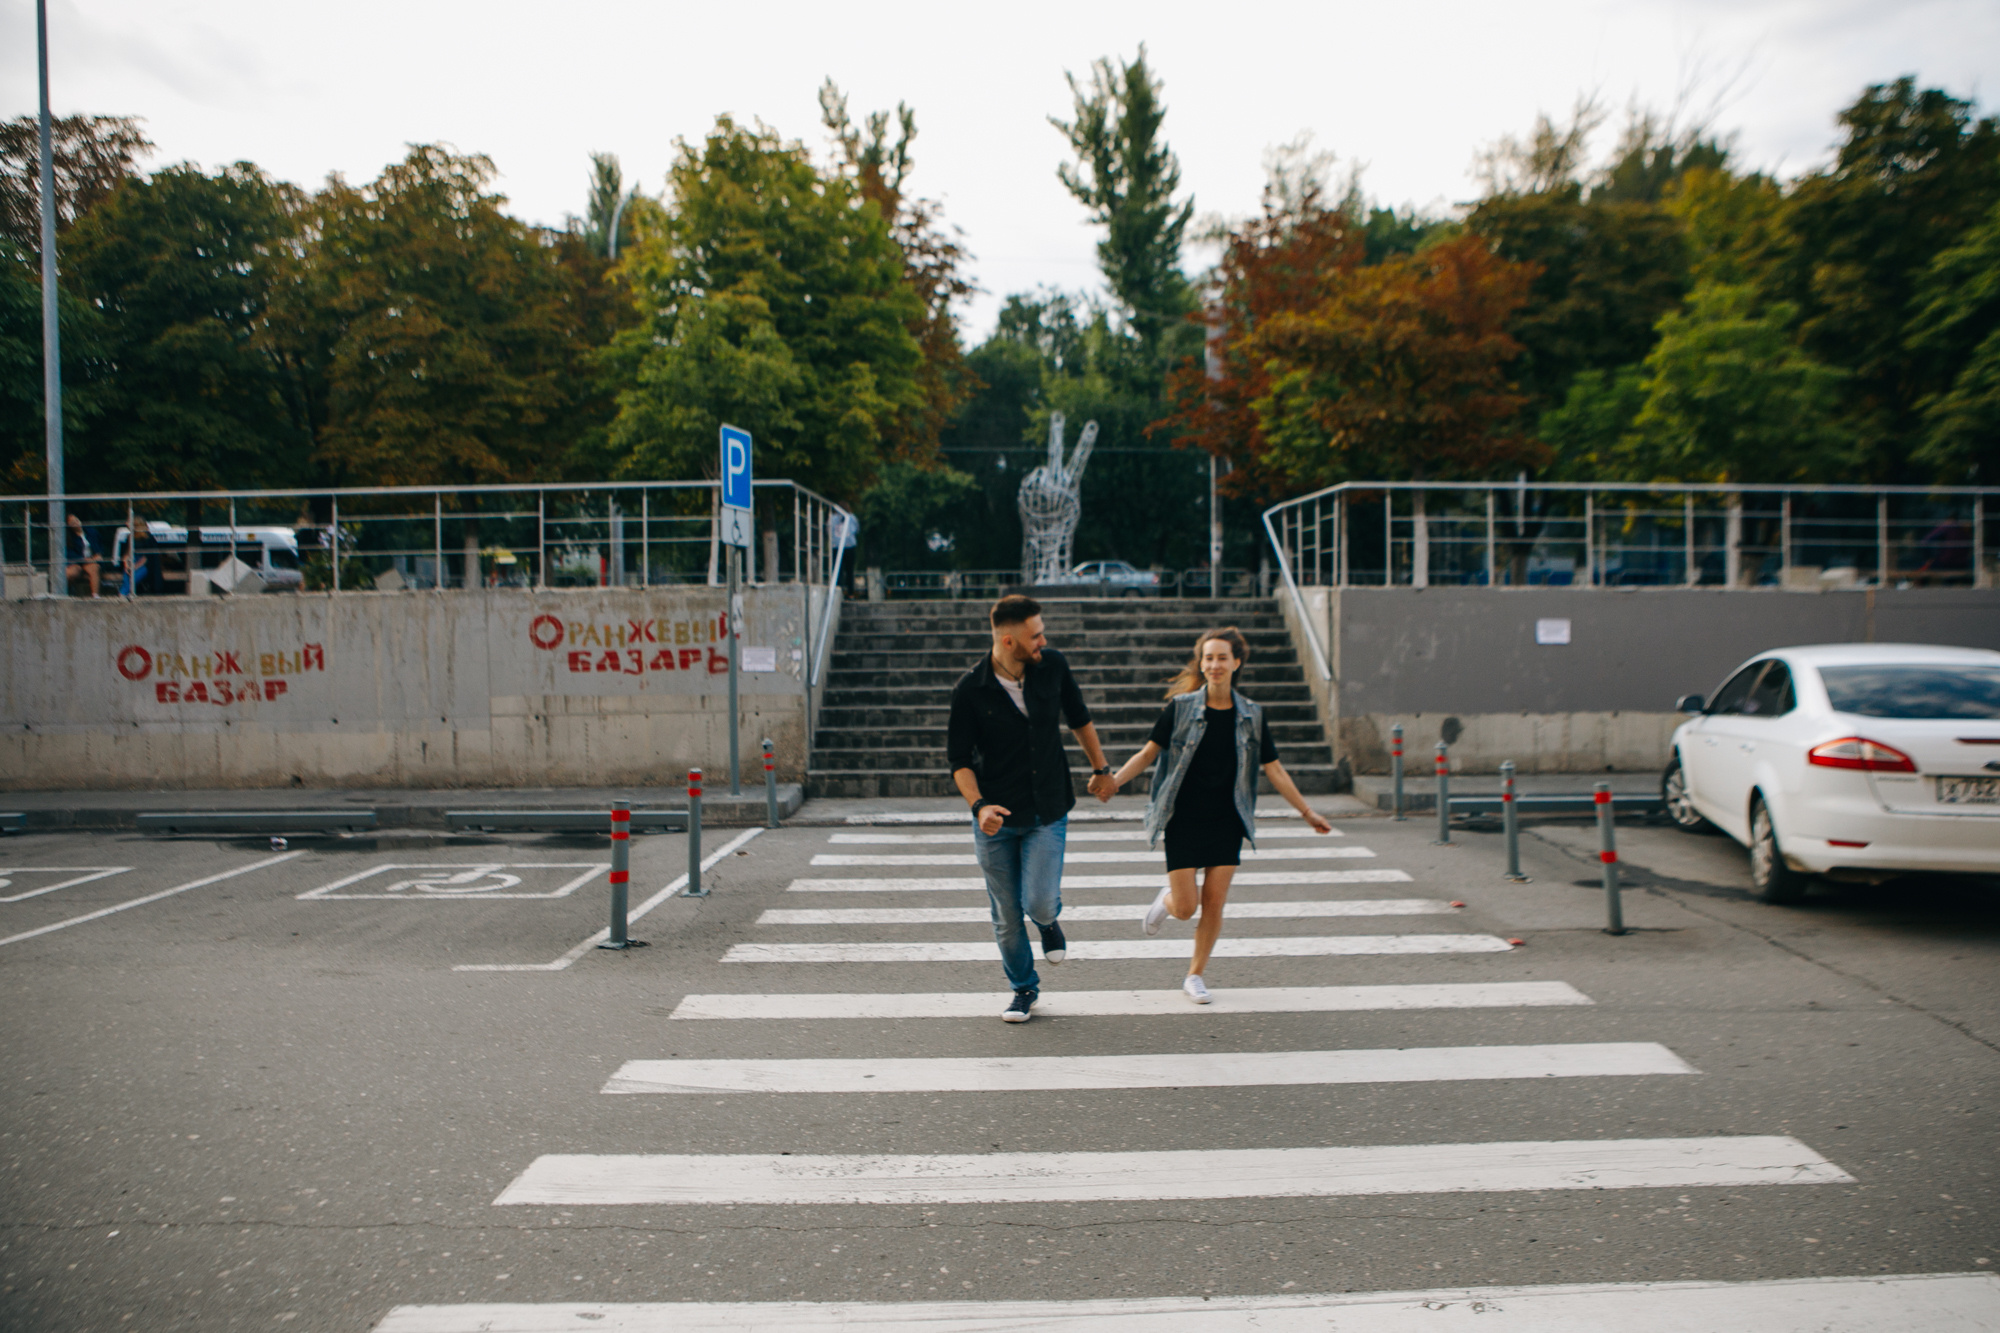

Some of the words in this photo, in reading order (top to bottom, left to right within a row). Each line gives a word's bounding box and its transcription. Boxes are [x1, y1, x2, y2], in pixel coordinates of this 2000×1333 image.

[728, 438, 746, 497] P
[117, 642, 325, 681] ОРАНЖВЫЙ
[155, 679, 288, 706] БАЗАР
